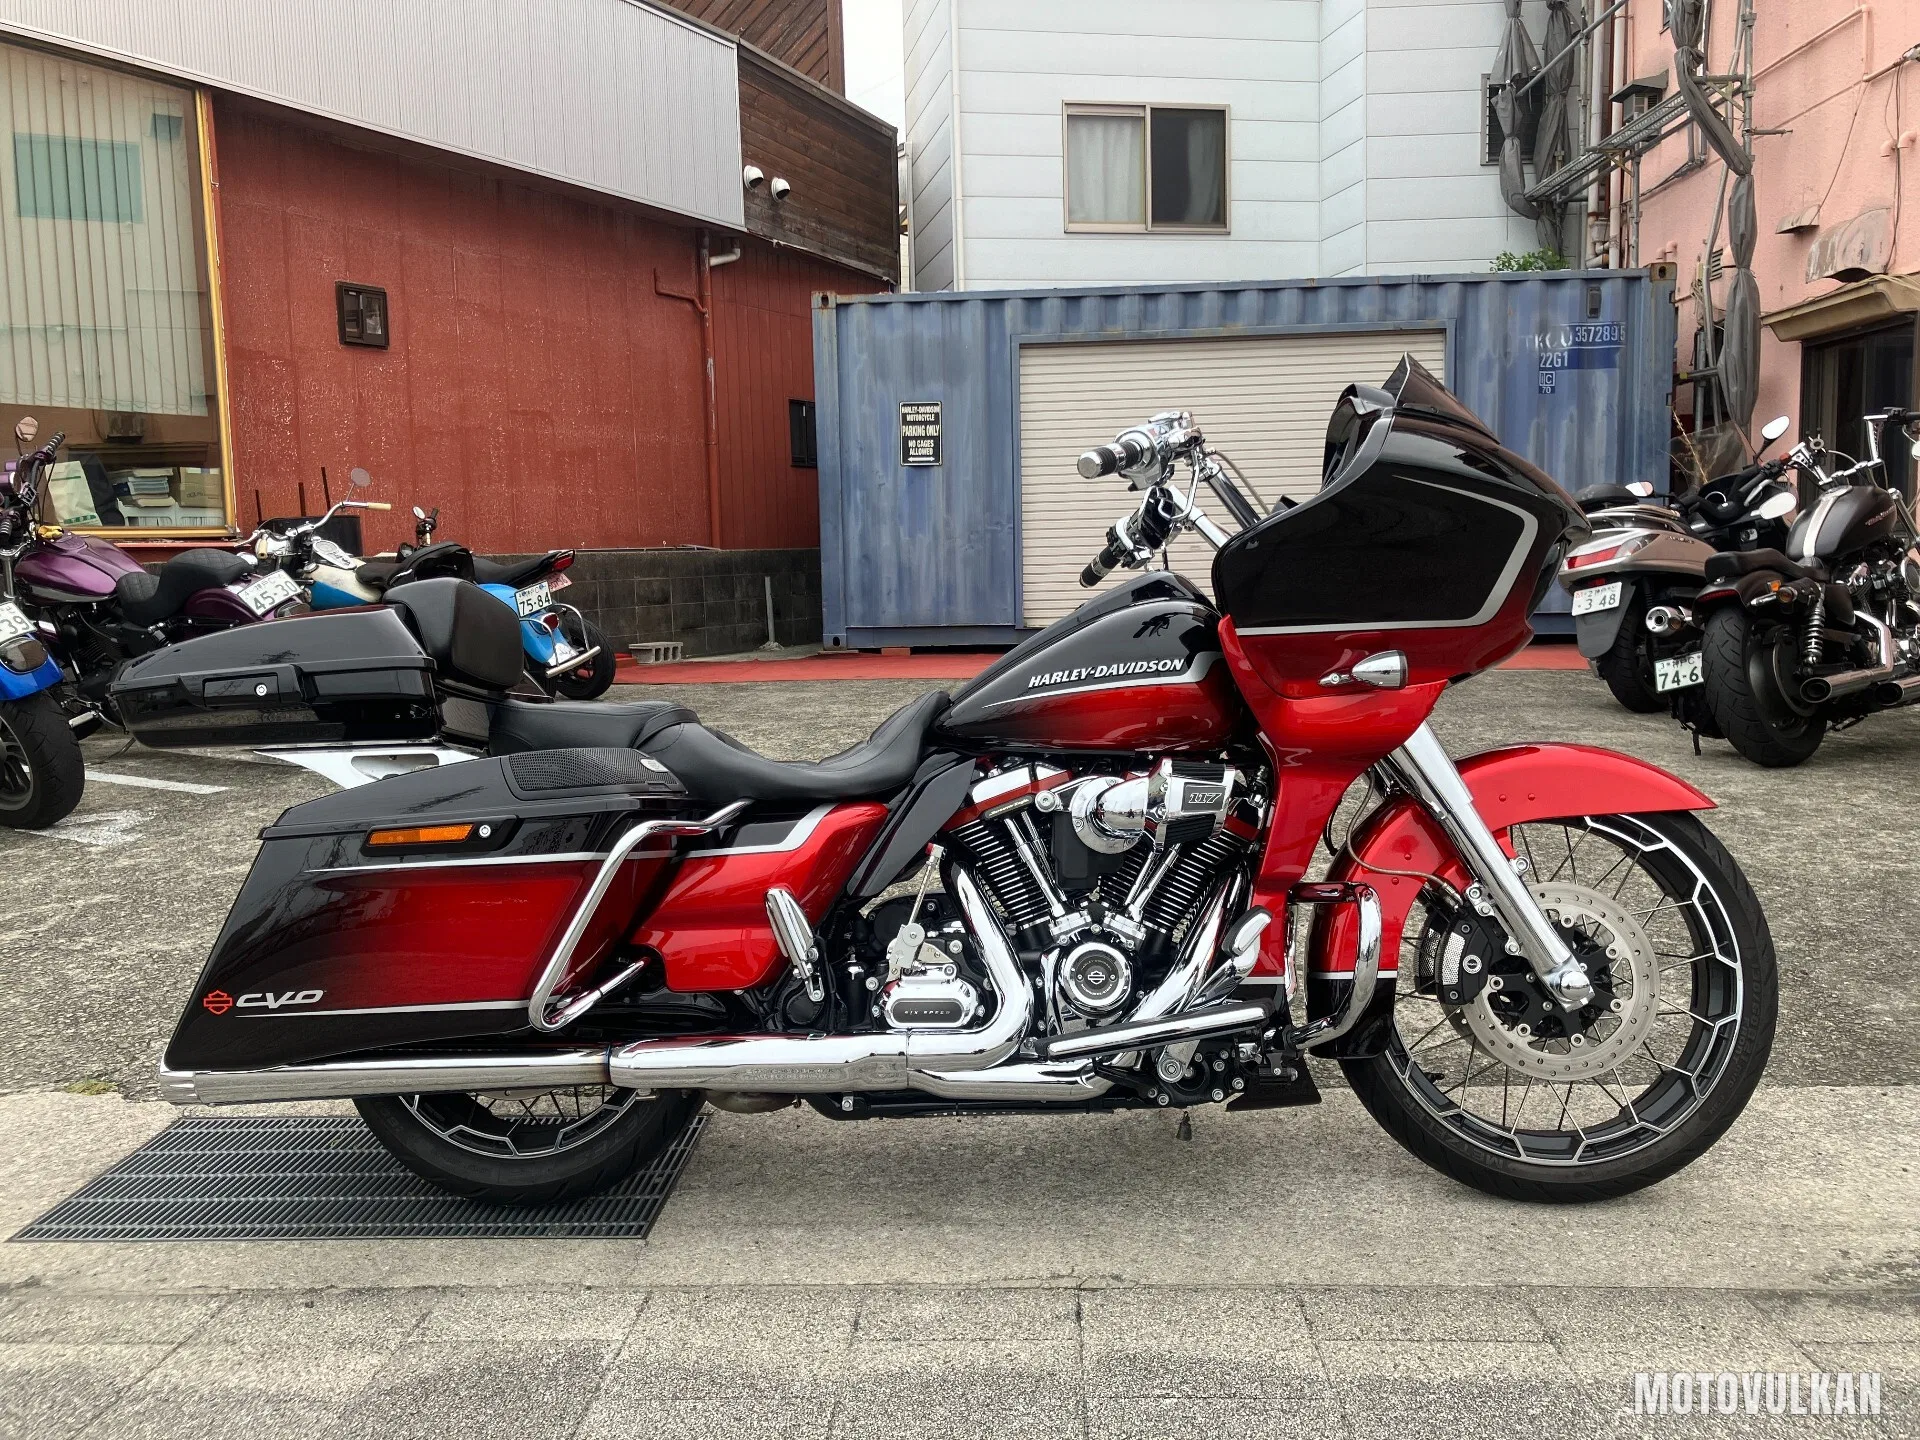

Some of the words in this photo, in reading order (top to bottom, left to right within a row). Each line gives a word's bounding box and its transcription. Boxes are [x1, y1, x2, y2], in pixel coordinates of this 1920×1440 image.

[1540, 351, 1568, 367] 22G1
[1541, 386, 1551, 394] 70
[901, 406, 940, 414] HARLEY-DAVIDSON
[902, 425, 925, 437] PARKING
[926, 425, 940, 436] ONLY
[519, 591, 551, 615] 75-84
[1028, 658, 1185, 688] HARLEY-DAVIDSON
[1659, 665, 1701, 689] 74-6
[1188, 793, 1222, 804] 117
[236, 989, 324, 1009] CVO
